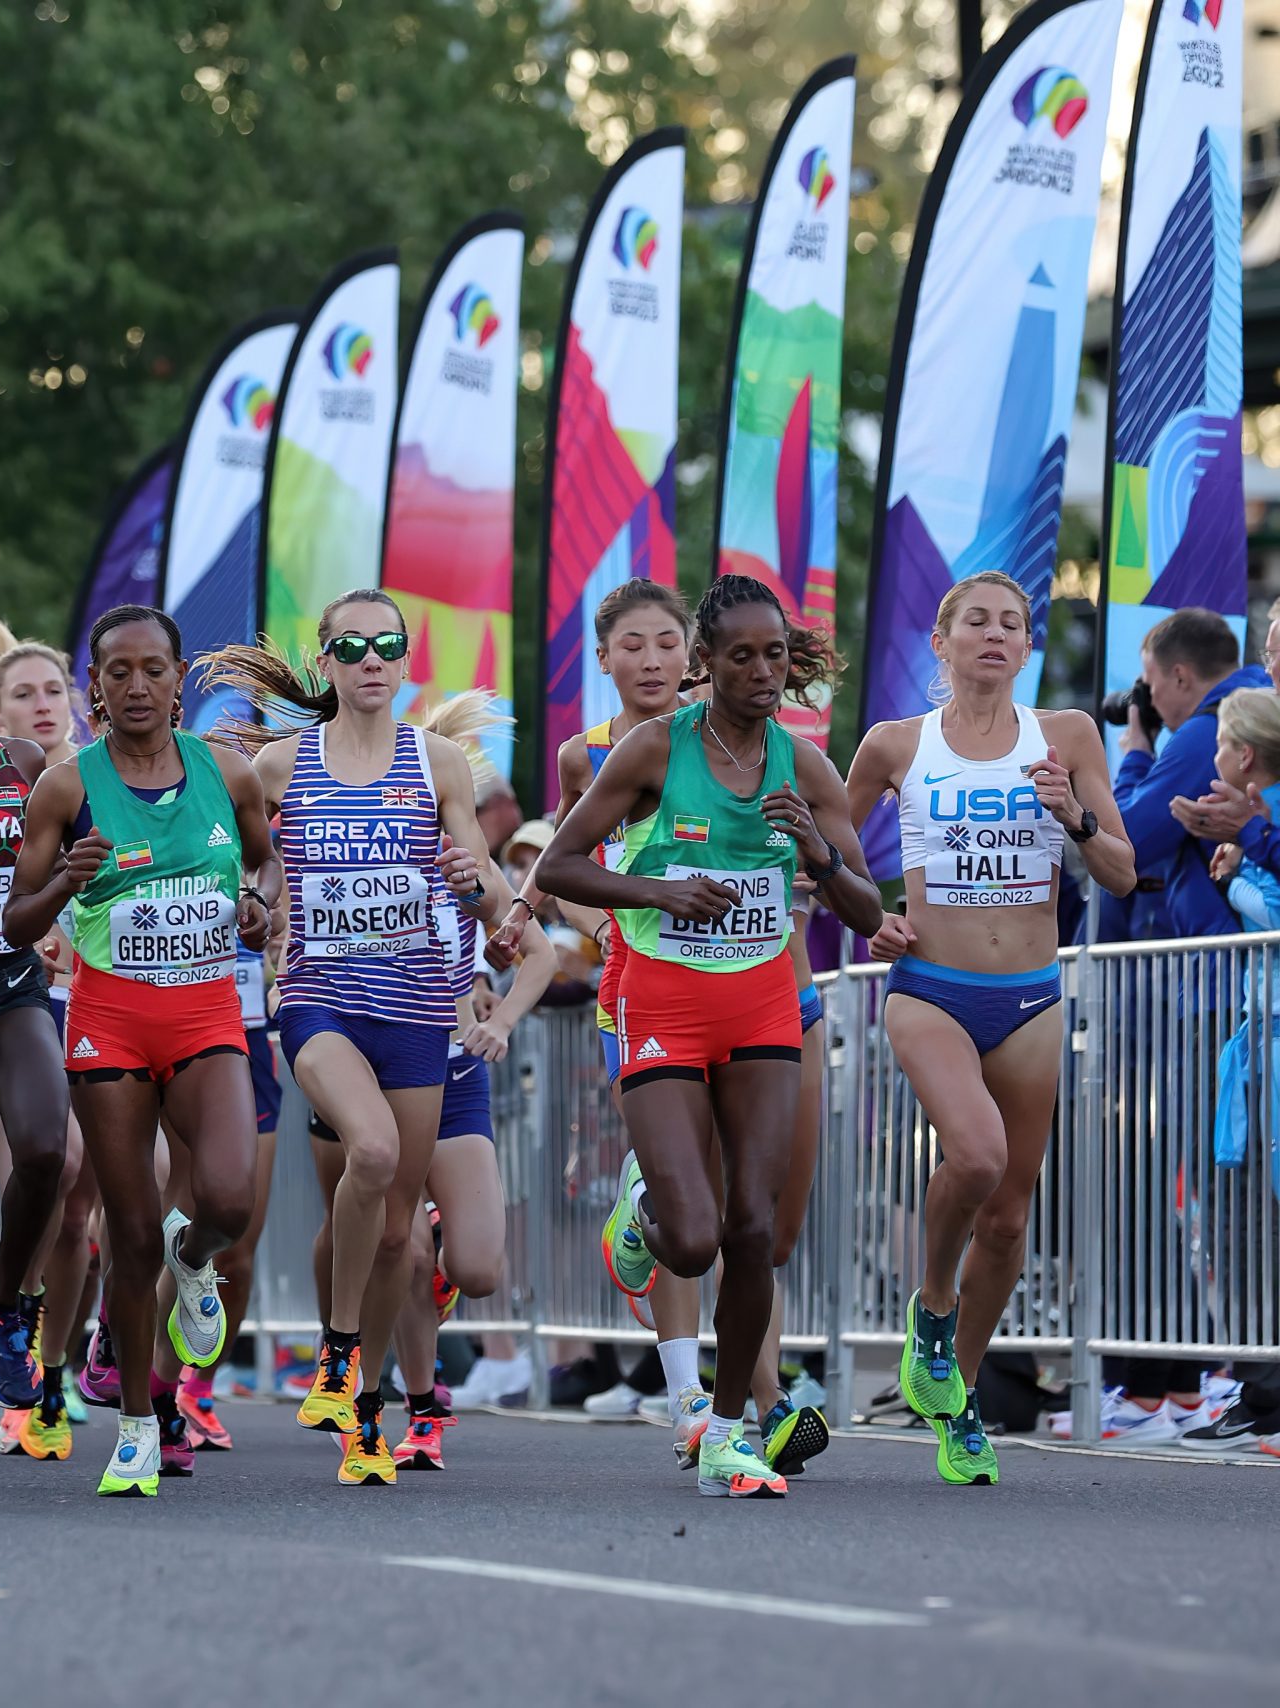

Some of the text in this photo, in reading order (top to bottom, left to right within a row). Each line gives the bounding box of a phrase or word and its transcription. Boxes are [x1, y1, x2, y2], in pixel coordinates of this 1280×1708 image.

[930, 786, 1042, 822] USA
[305, 822, 410, 840] GREAT
[976, 829, 1034, 849] QNB
[305, 843, 410, 861] BRITAIN
[956, 854, 1026, 881] HALL
[352, 874, 411, 898] QNB
[947, 890, 1033, 905] OREGON22
[165, 899, 219, 926] QNB
[312, 900, 419, 935] PIASECKI
[119, 925, 231, 962] GEBRESLASE
[326, 938, 410, 955] OREGON22
[680, 944, 764, 959] OREGON22
[134, 966, 220, 985] OREGON22
[636, 1050, 667, 1061] adidas
